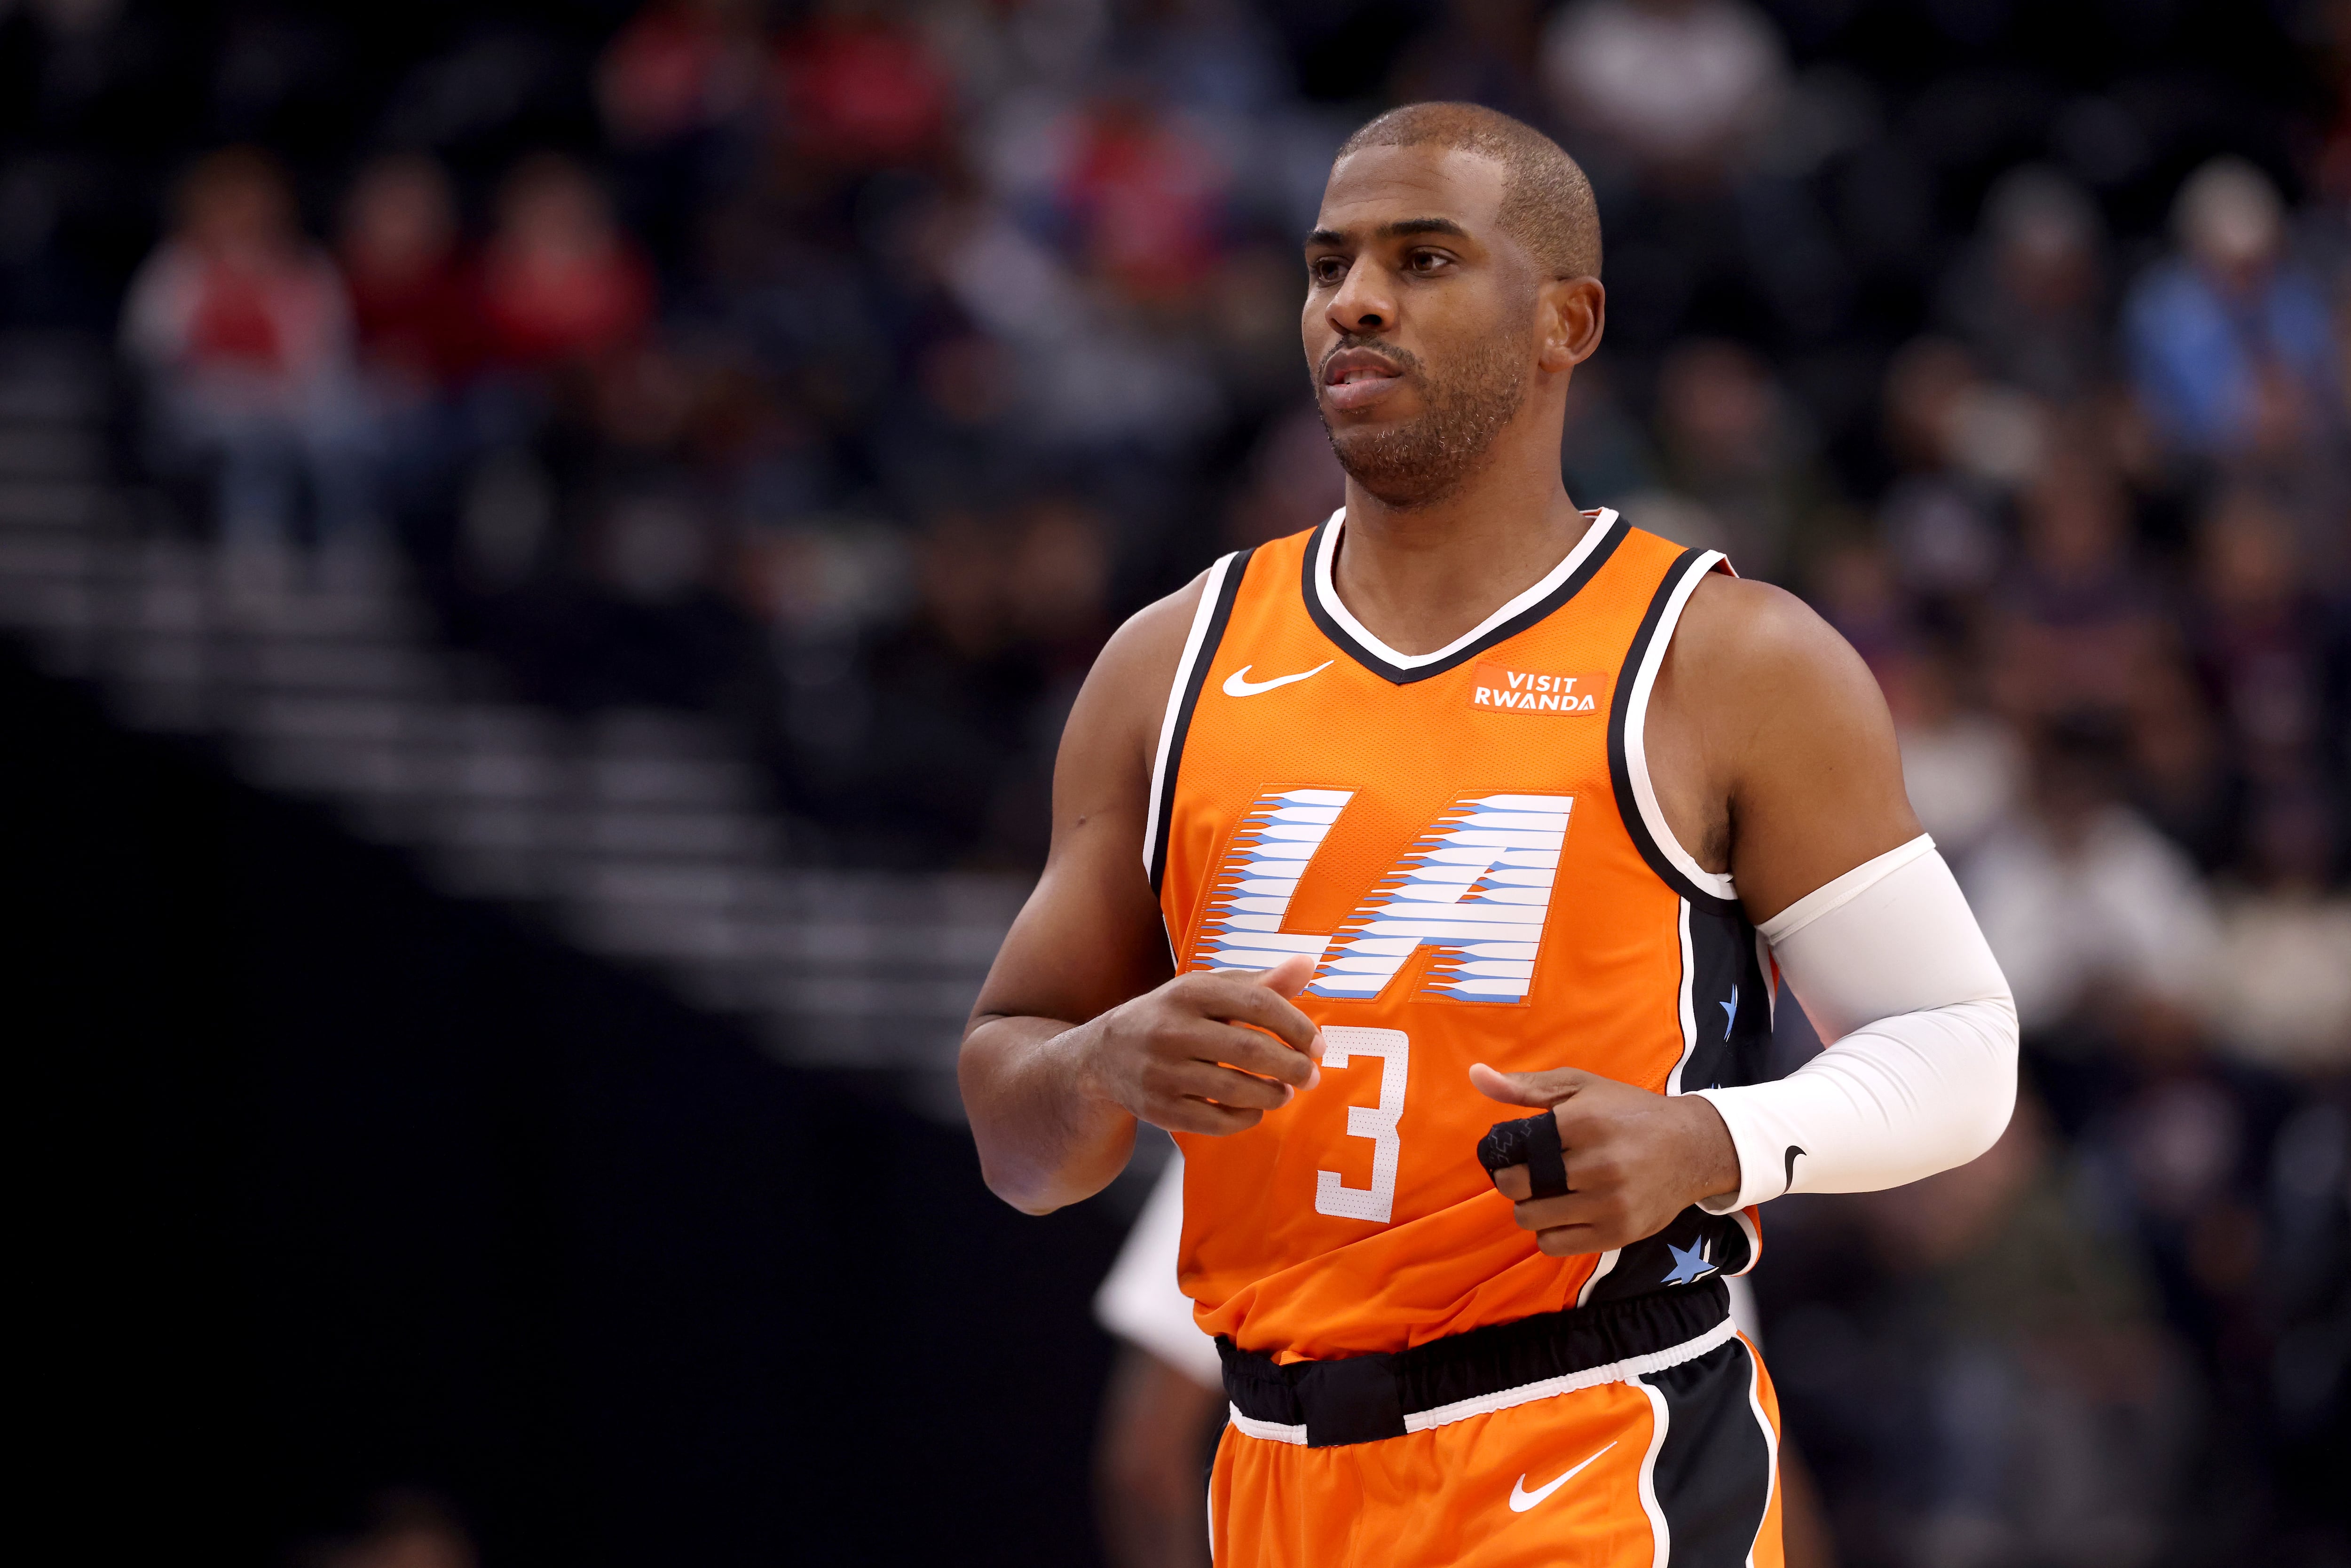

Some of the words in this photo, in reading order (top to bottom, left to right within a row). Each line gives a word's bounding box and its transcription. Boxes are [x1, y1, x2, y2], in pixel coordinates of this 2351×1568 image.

[1474, 686, 1595, 711] RWANDA
[1507, 671, 1578, 693] VISIT
[1191, 788, 1574, 1004] LA
[1315, 1025, 1409, 1224] 3
